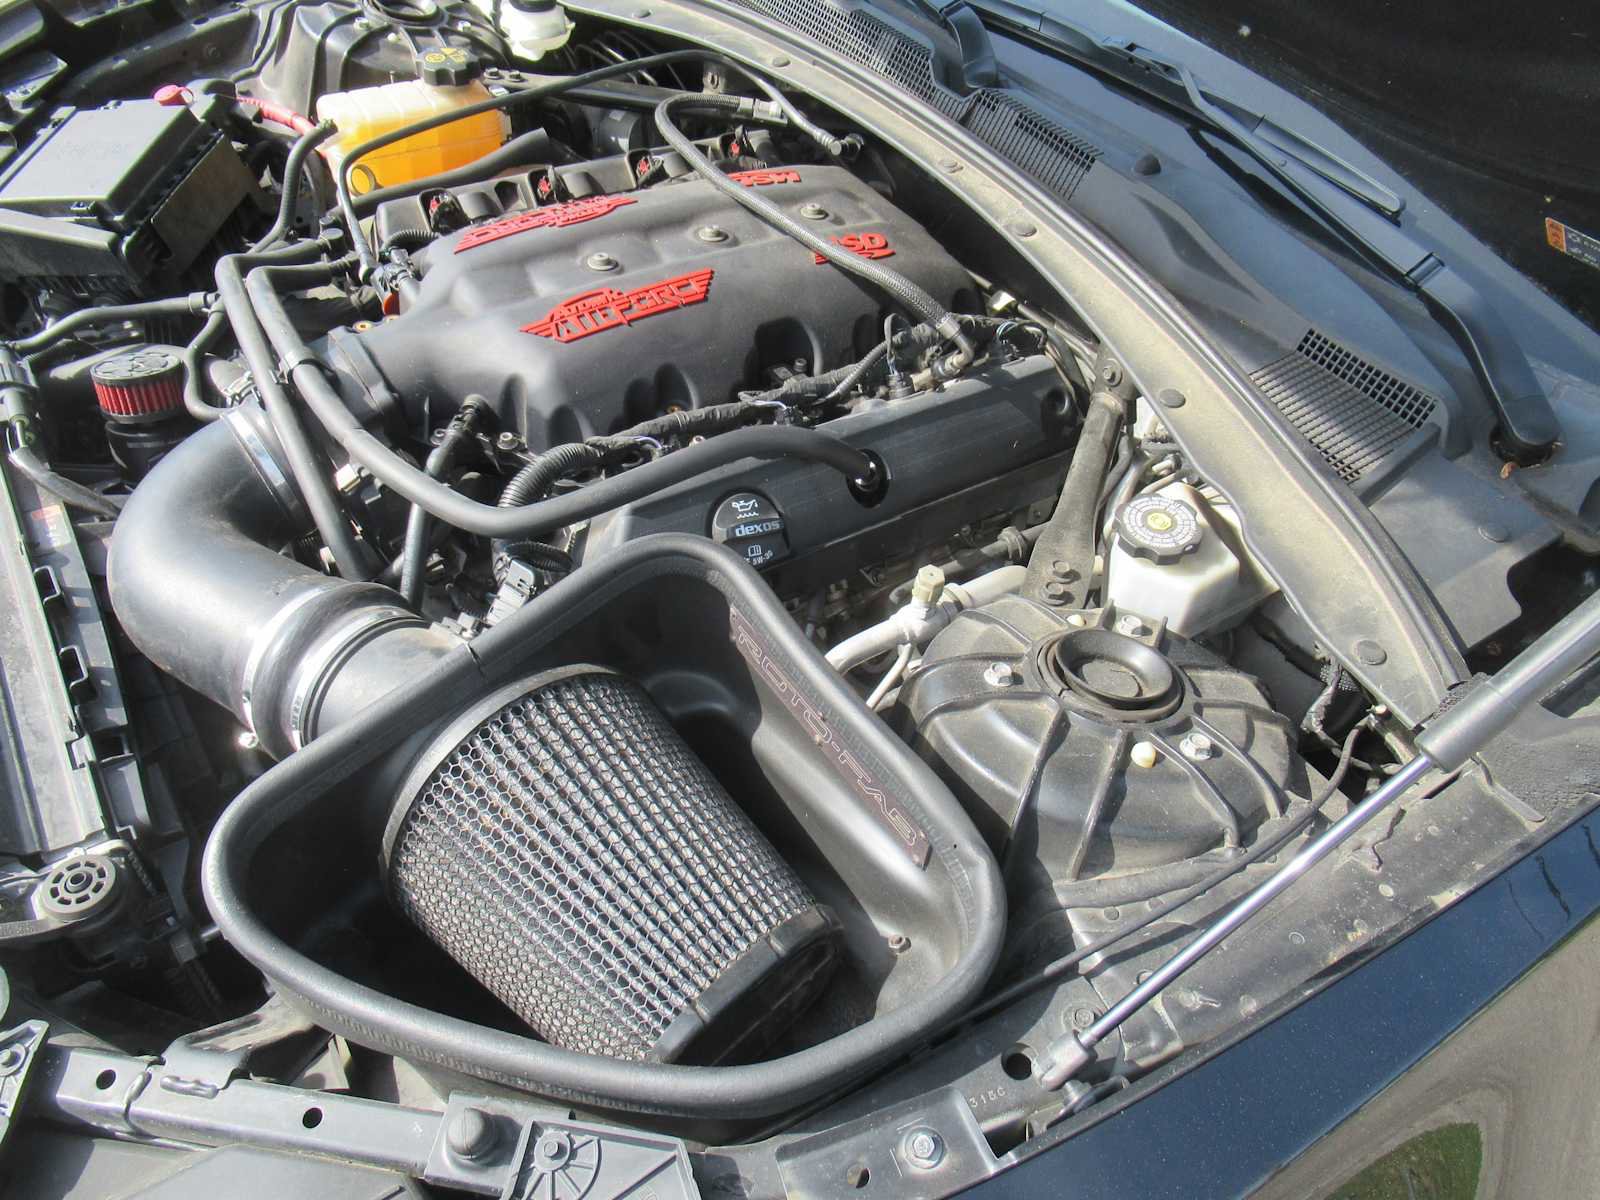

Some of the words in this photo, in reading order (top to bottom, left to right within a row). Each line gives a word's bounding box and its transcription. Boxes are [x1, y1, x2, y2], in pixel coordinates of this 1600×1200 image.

[831, 231, 889, 252] SD
[735, 520, 781, 537] dexos
[737, 624, 917, 846] ROTO-FAB
